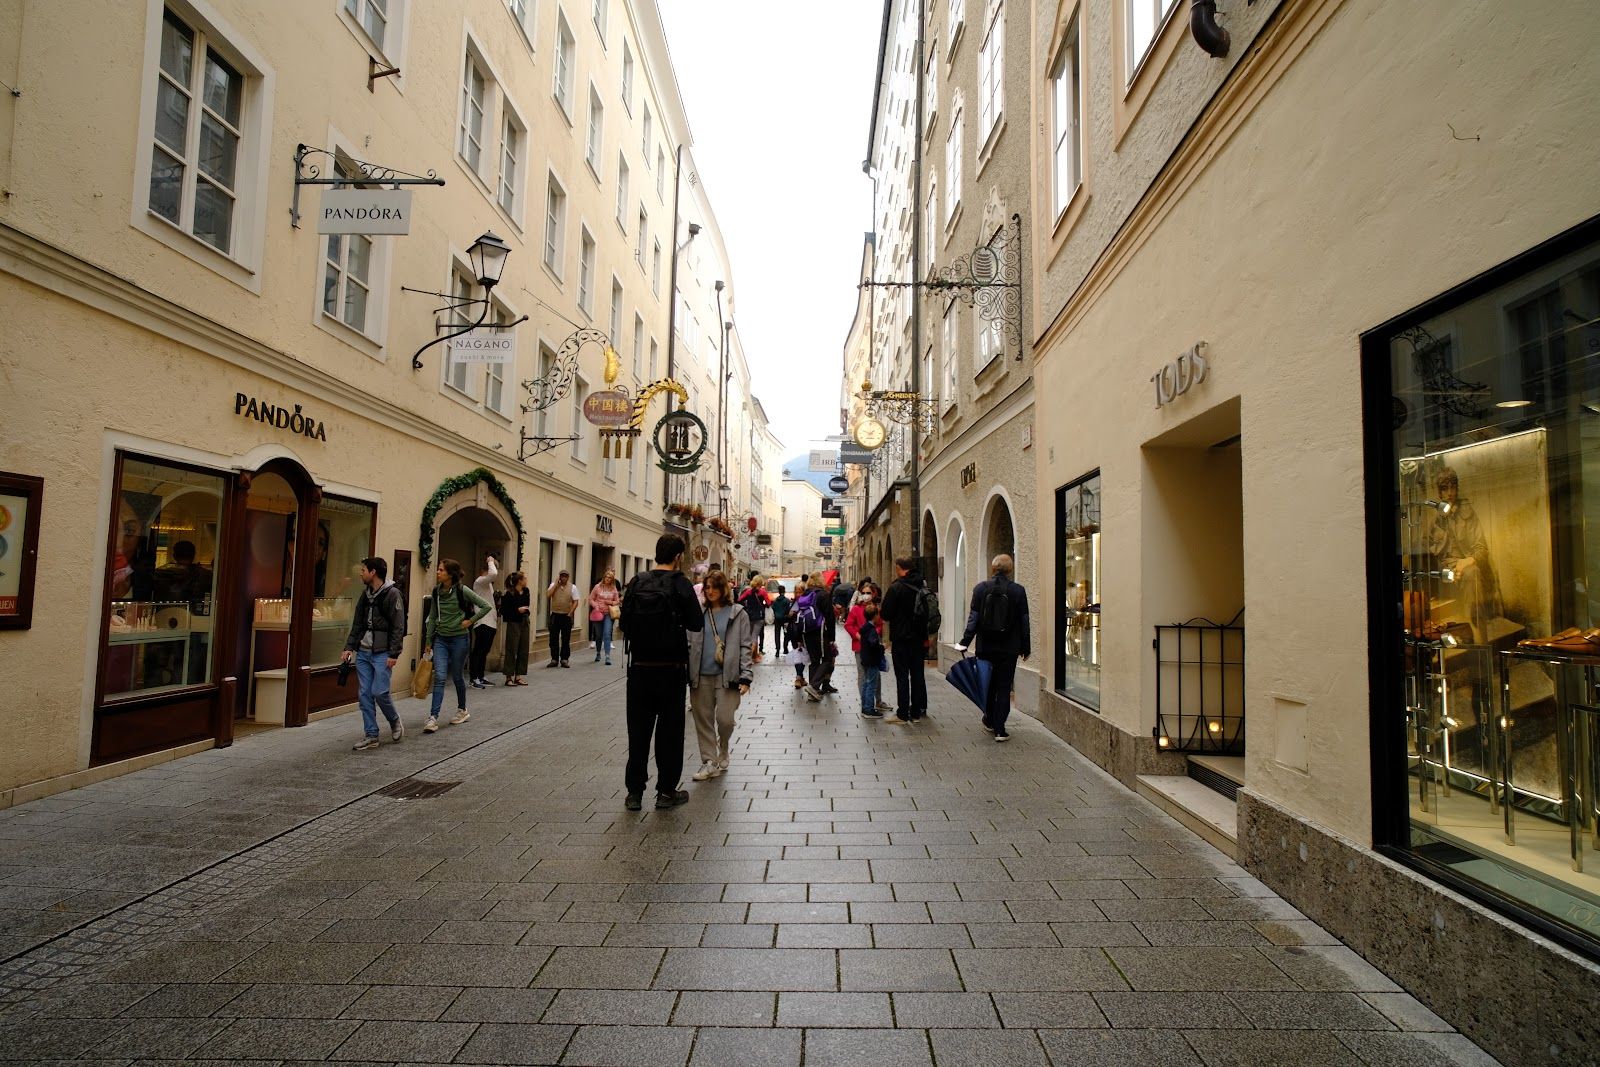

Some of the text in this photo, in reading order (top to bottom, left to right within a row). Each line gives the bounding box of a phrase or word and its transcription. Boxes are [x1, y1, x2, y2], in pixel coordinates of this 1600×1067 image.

[324, 205, 403, 220] PANDORA
[455, 340, 511, 349] NAGANO
[234, 392, 327, 442] PANDORA
